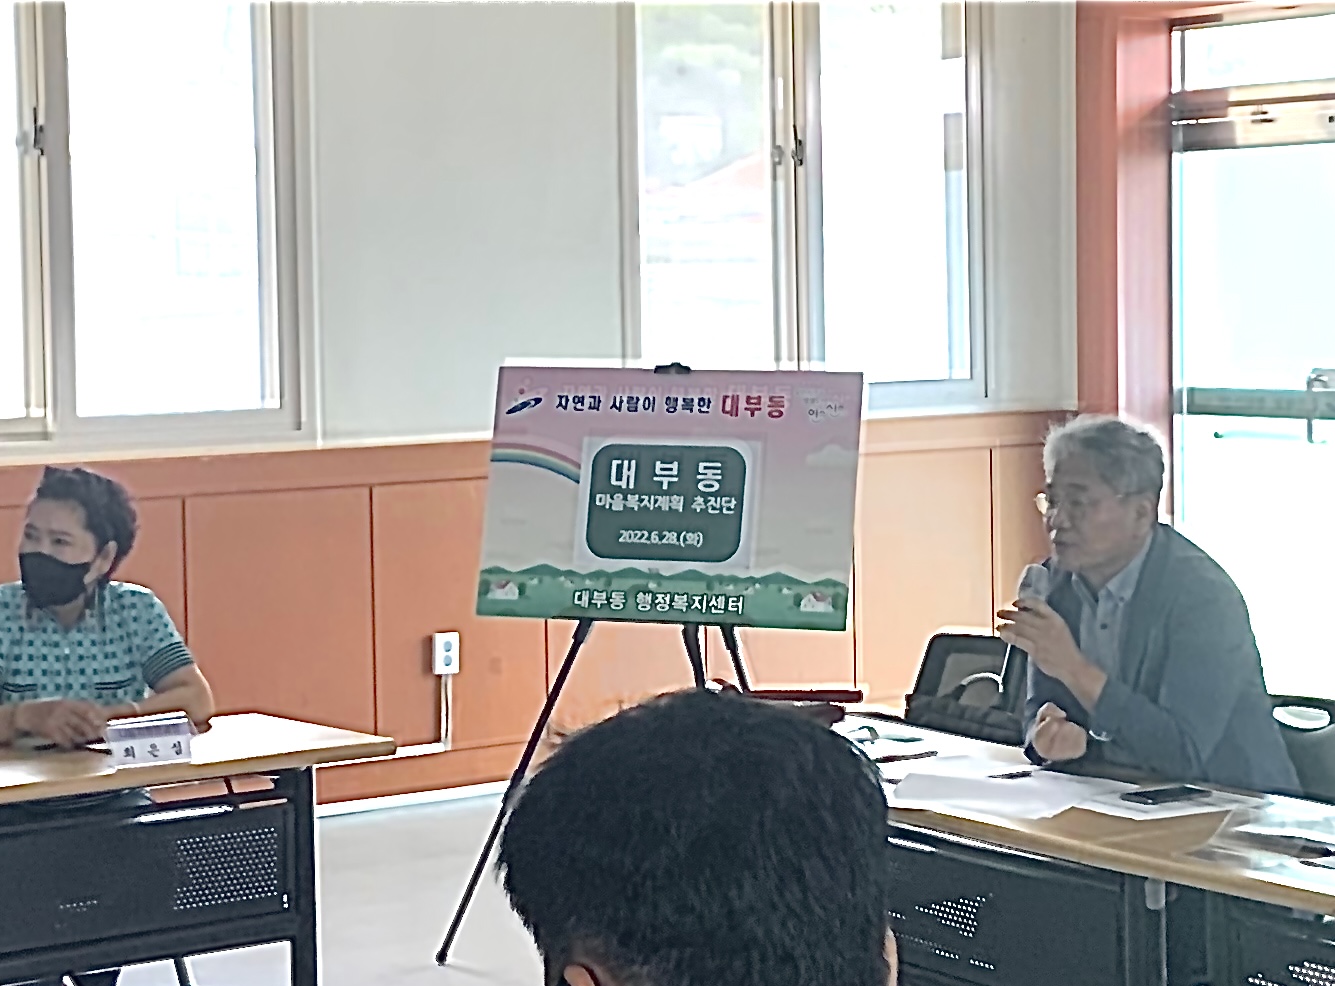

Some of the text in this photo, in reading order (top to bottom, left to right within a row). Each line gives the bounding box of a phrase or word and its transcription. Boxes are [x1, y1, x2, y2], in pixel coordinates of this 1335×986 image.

[556, 394, 602, 412] 자연과
[609, 395, 656, 413] 사람이
[665, 396, 712, 415] 행복한
[721, 394, 785, 419] 대부동
[595, 493, 737, 515] 마을복지계획 추진단
[618, 529, 704, 548] 2022.6.28.(화)
[573, 590, 745, 615] 대부동 행정복지센터
